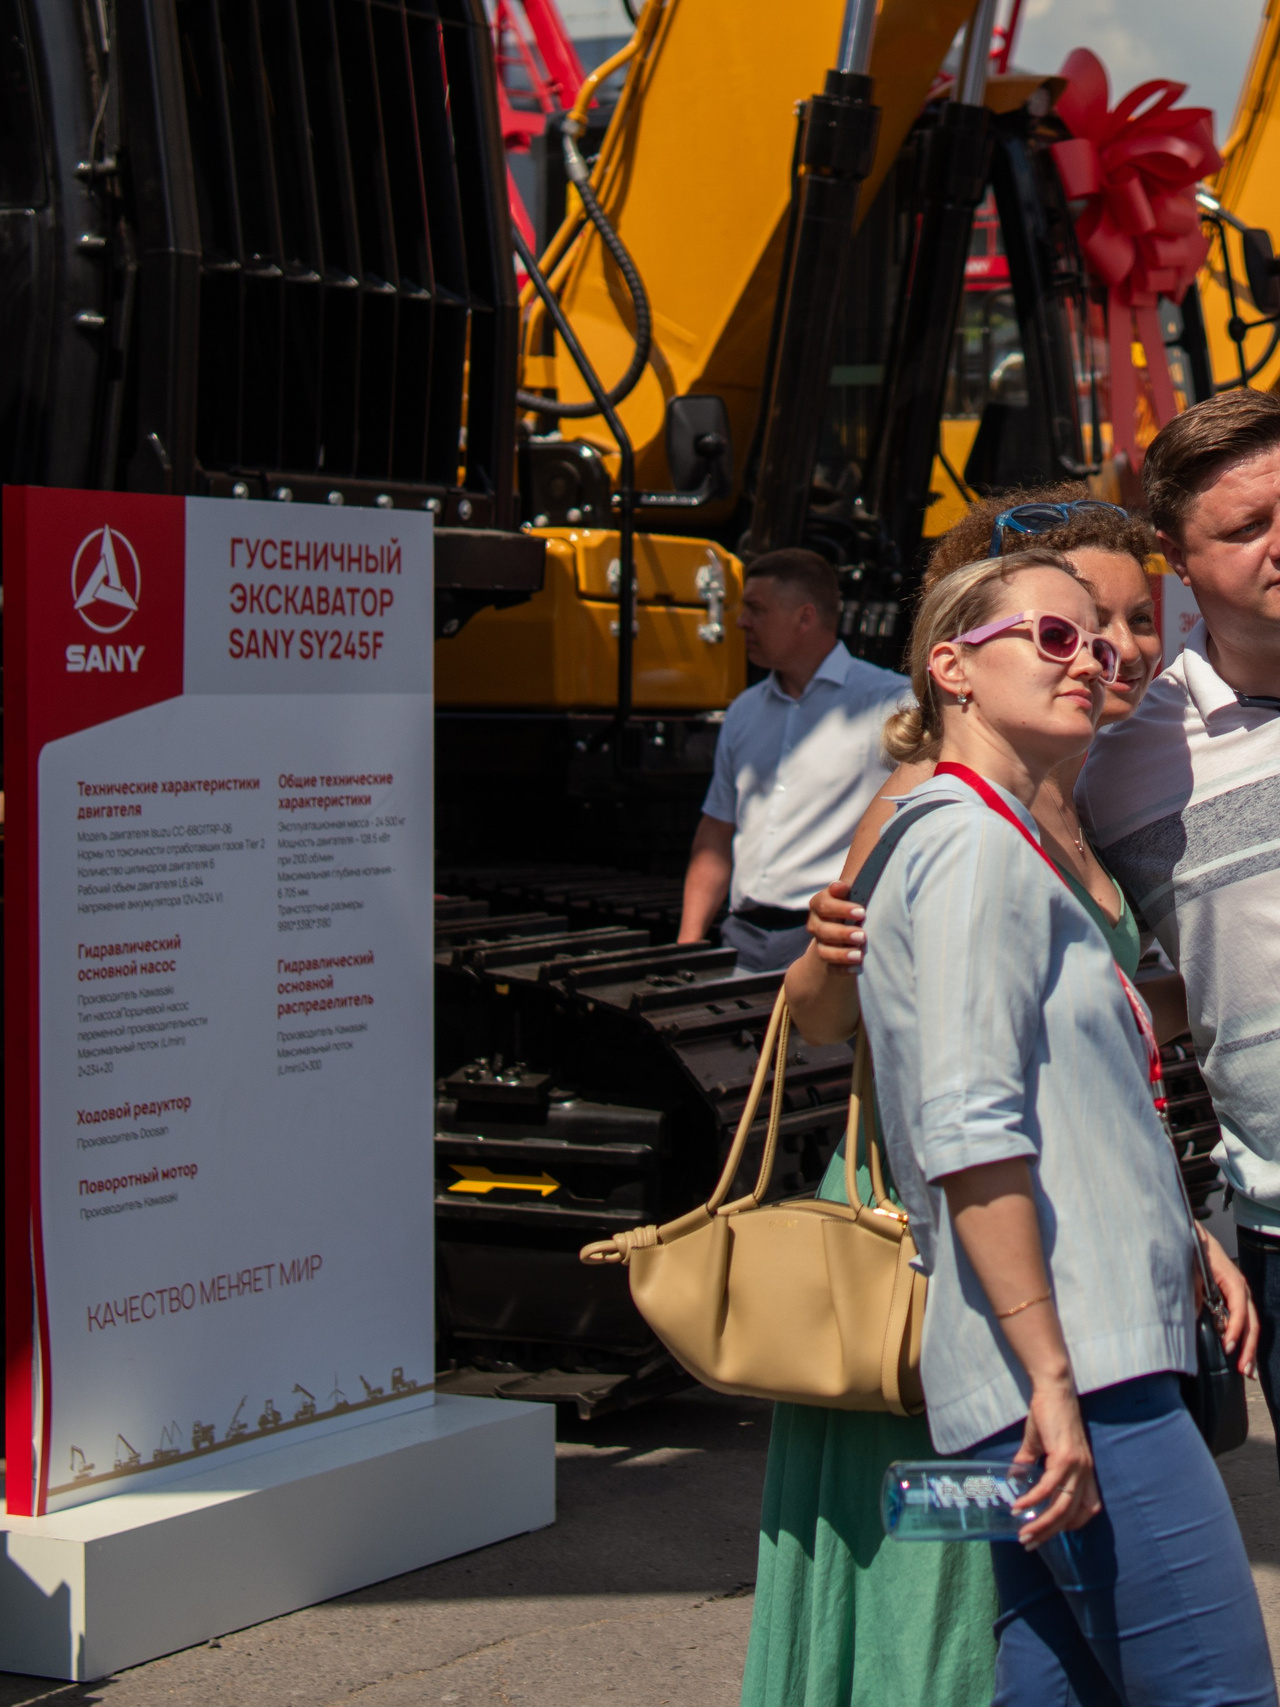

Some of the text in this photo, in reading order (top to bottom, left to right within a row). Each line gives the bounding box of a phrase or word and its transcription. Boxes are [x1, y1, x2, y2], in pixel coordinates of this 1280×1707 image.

[230, 537, 401, 575] ГУСЕНИЧНЫЙ
[229, 583, 394, 617] ЭКСКАВАТОР
[229, 628, 384, 660] SANY SY245F
[66, 644, 145, 672] SANY
[77, 778, 260, 797] Технические характеристики
[278, 772, 394, 789] Общие технические
[77, 804, 142, 820] двигателя
[278, 794, 372, 813] характеристики
[77, 934, 182, 962] Гидравлический
[77, 958, 177, 982] основной насос
[277, 950, 374, 976] Гидравлический
[277, 974, 334, 995] основной
[277, 993, 374, 1020] распределитель
[77, 1096, 192, 1126] Ходовой редуктор
[78, 1162, 198, 1196] Поворотный мотор
[87, 1253, 323, 1332] КАЧЕСТВО МЕНЯЕТ МИР
